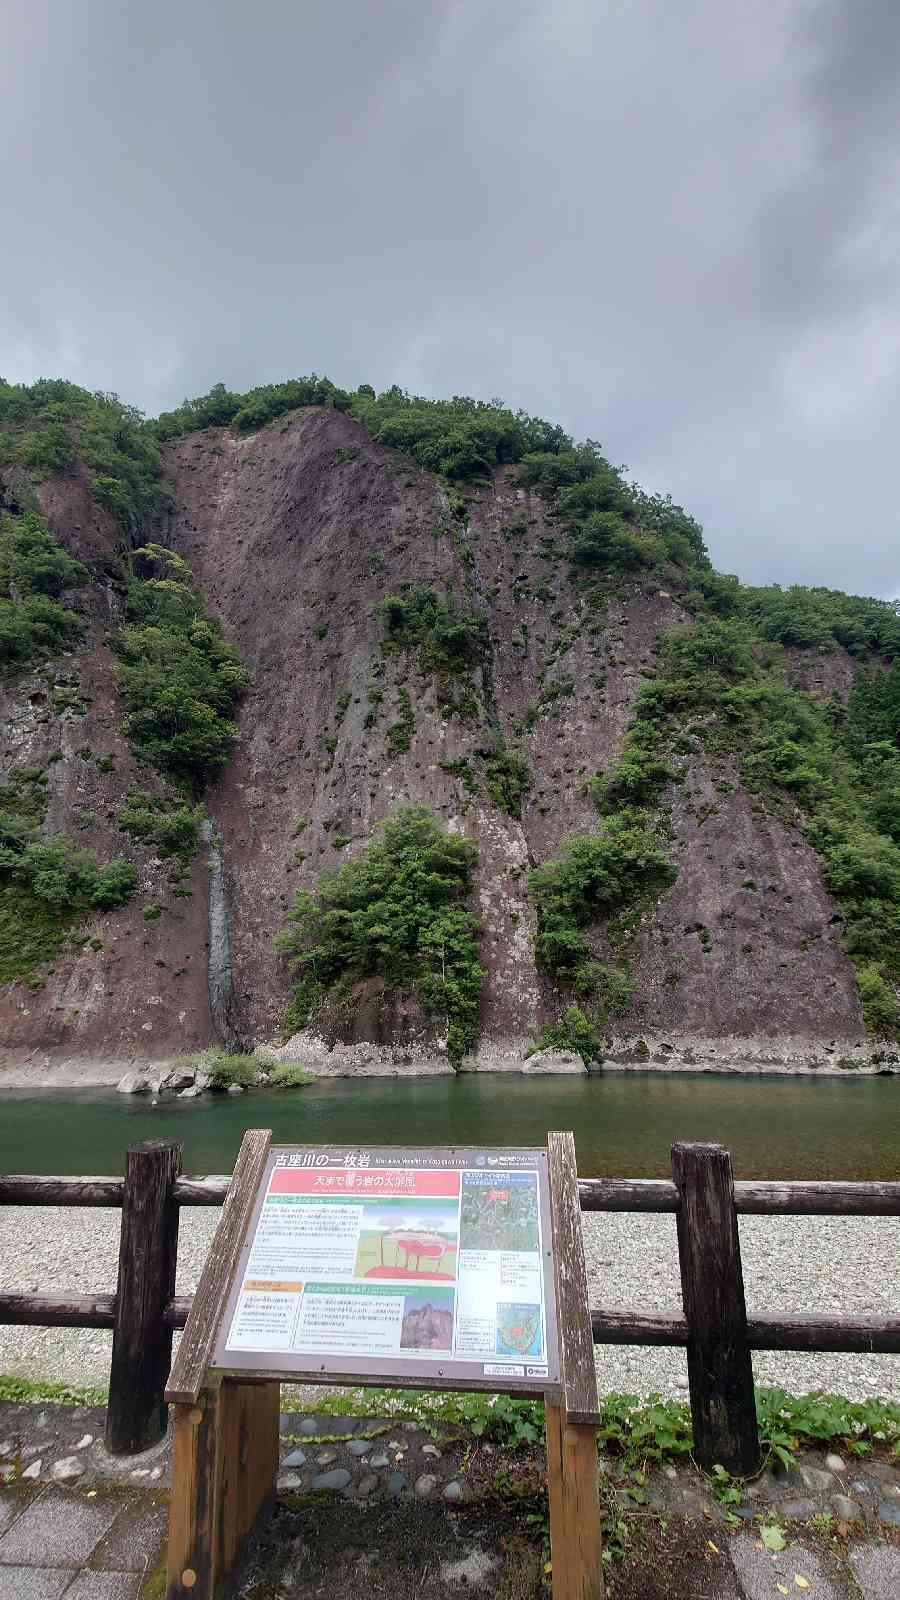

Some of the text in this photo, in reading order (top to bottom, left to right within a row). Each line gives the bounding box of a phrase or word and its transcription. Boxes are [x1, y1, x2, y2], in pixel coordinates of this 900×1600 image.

[274, 1153, 371, 1168] 古座川の一枚岩
